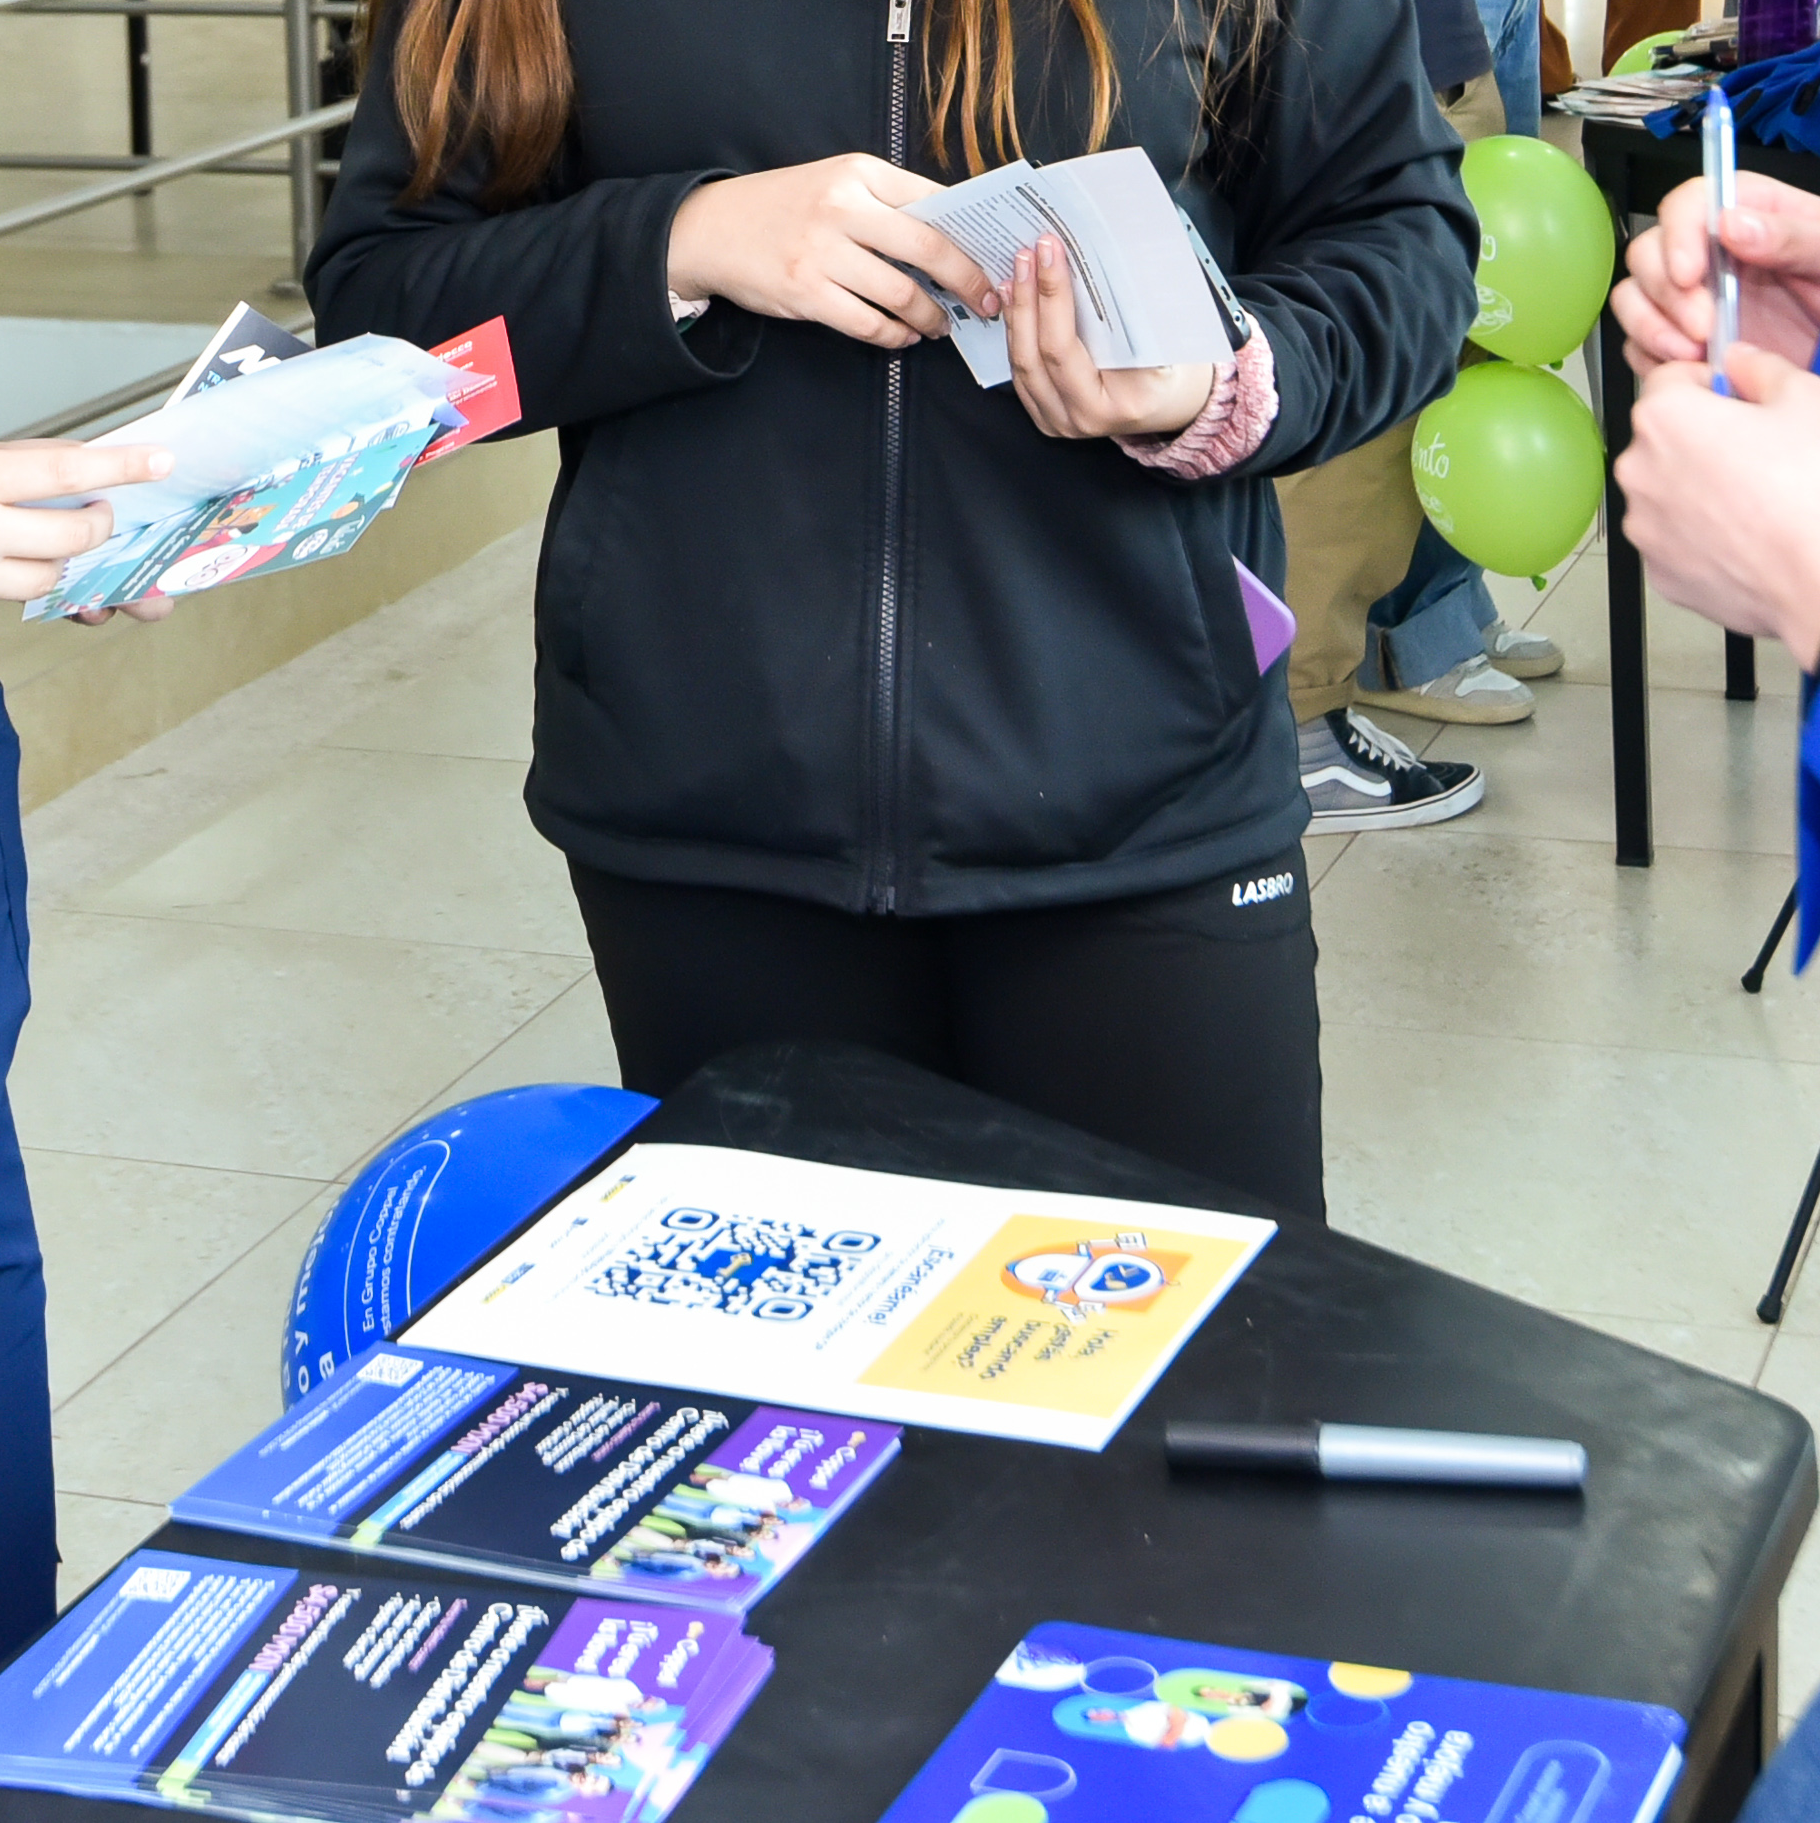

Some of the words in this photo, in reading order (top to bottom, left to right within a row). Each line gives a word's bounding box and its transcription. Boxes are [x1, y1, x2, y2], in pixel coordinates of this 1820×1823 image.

[1232, 872, 1294, 907] LASBRO
[369, 1185, 400, 1244] Coppel
[361, 1246, 378, 1306] Grupo
[362, 1309, 375, 1334] En
[810, 1446, 857, 1489] Coppel
[281, 1583, 338, 1634] $4,500
[251, 1631, 294, 1673] MXN
[658, 1637, 699, 1686] Coppel
